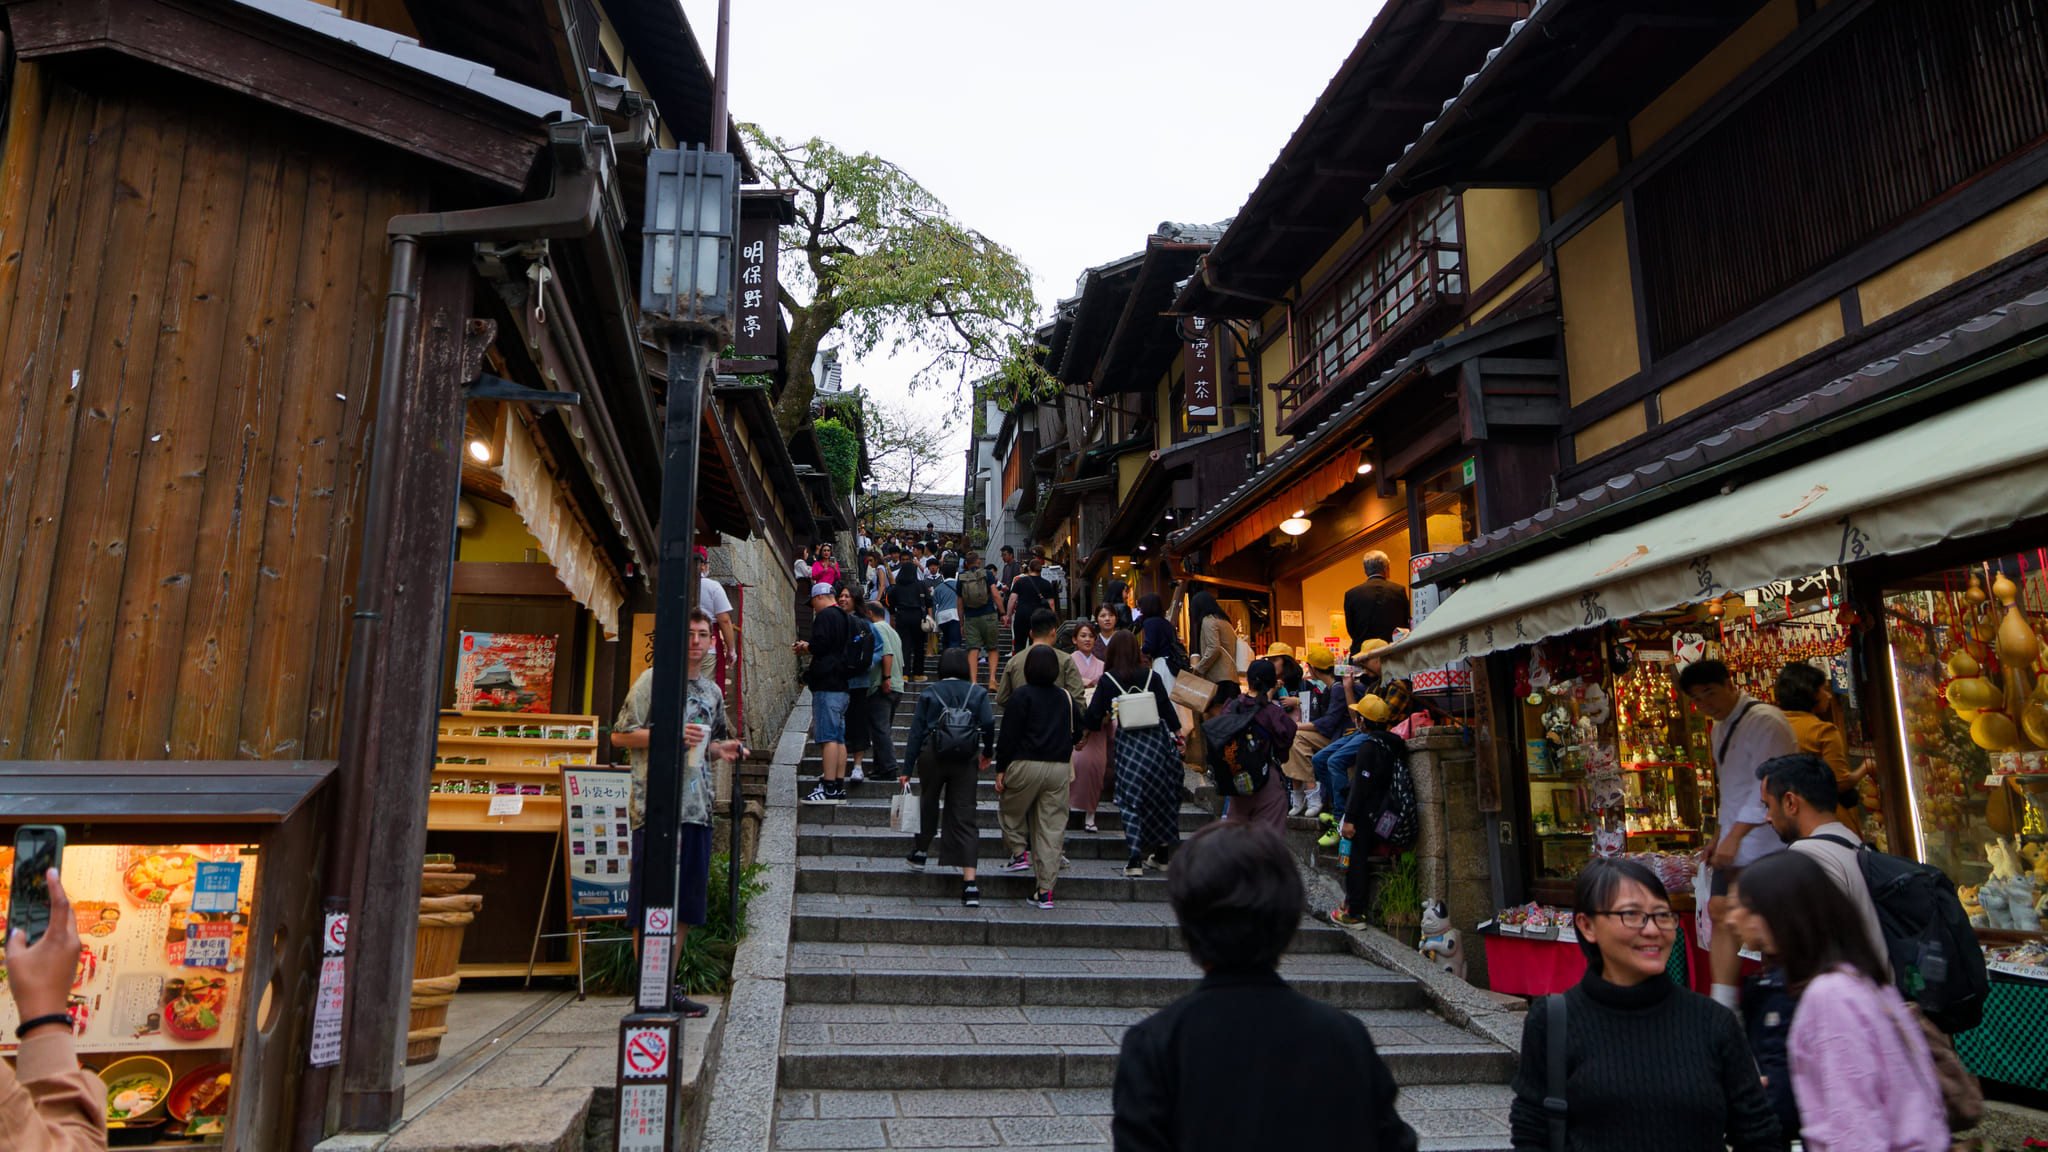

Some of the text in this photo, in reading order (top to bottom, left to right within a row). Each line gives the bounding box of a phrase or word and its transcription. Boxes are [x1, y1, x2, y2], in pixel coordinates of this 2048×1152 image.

[743, 240, 764, 338] 明保野亭
[581, 785, 628, 799] 小袋セット
